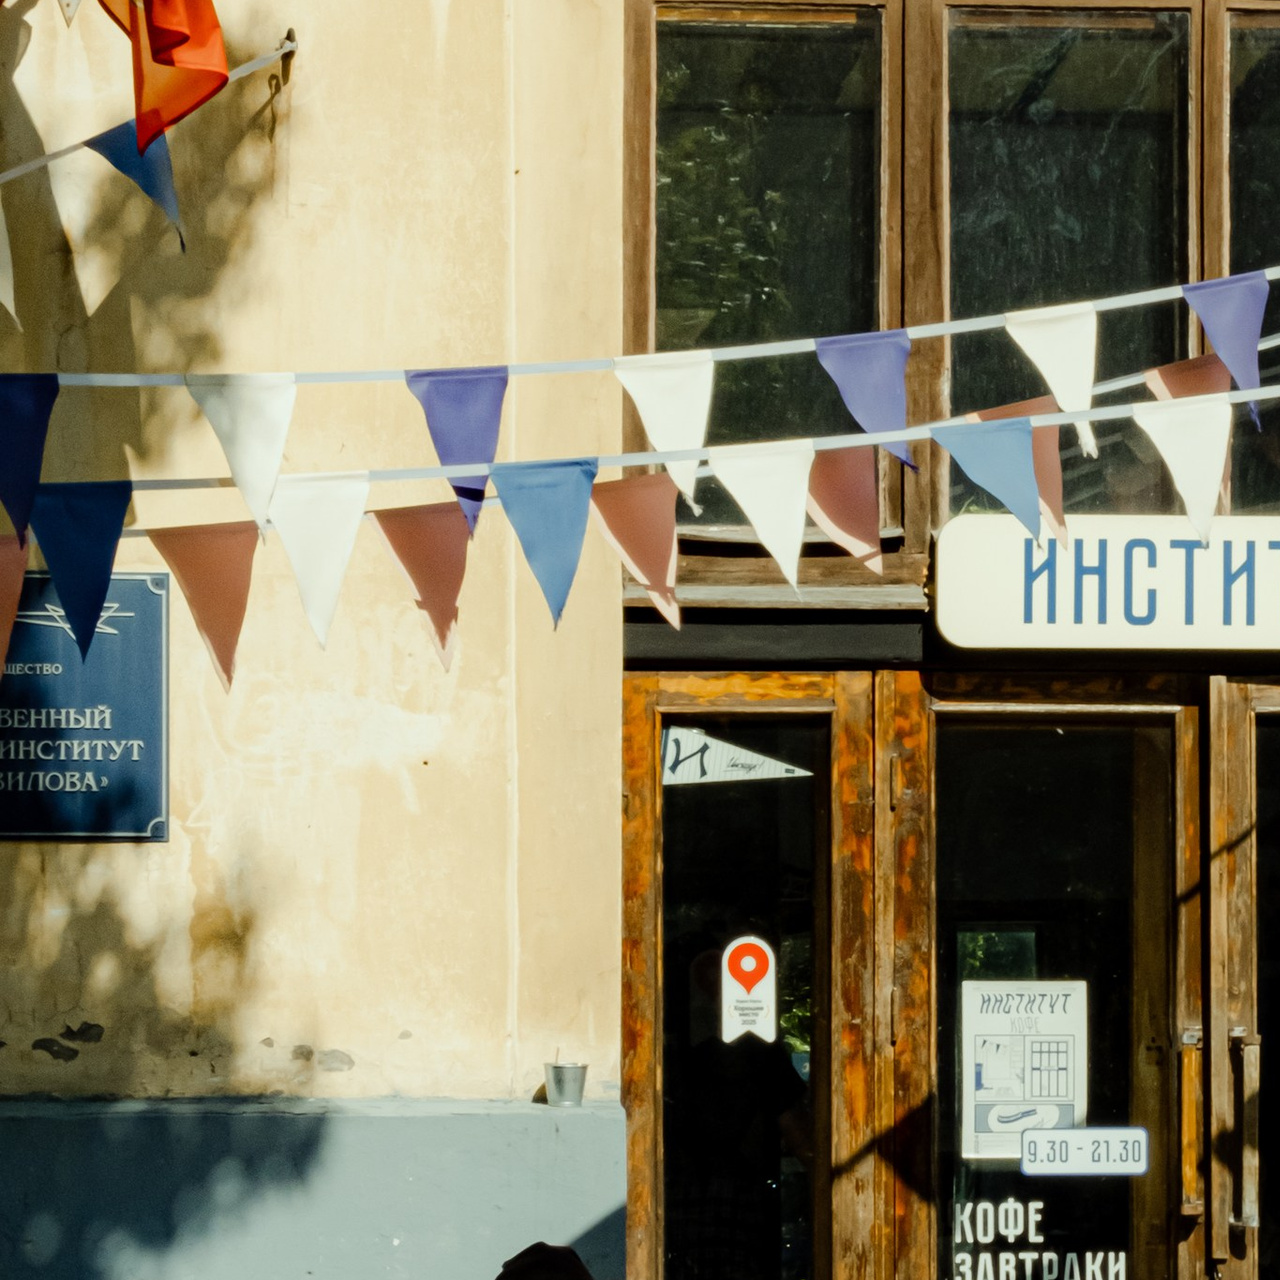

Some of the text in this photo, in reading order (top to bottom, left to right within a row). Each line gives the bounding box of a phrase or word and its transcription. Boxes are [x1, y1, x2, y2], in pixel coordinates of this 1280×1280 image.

[0, 740, 144, 760] ИНСТИТУТ
[1009, 1017, 1041, 1034] КОФЕ
[1028, 1140, 1069, 1163] 9.30
[1091, 1140, 1142, 1163] 21.30
[954, 1197, 1044, 1243] КОФЕ
